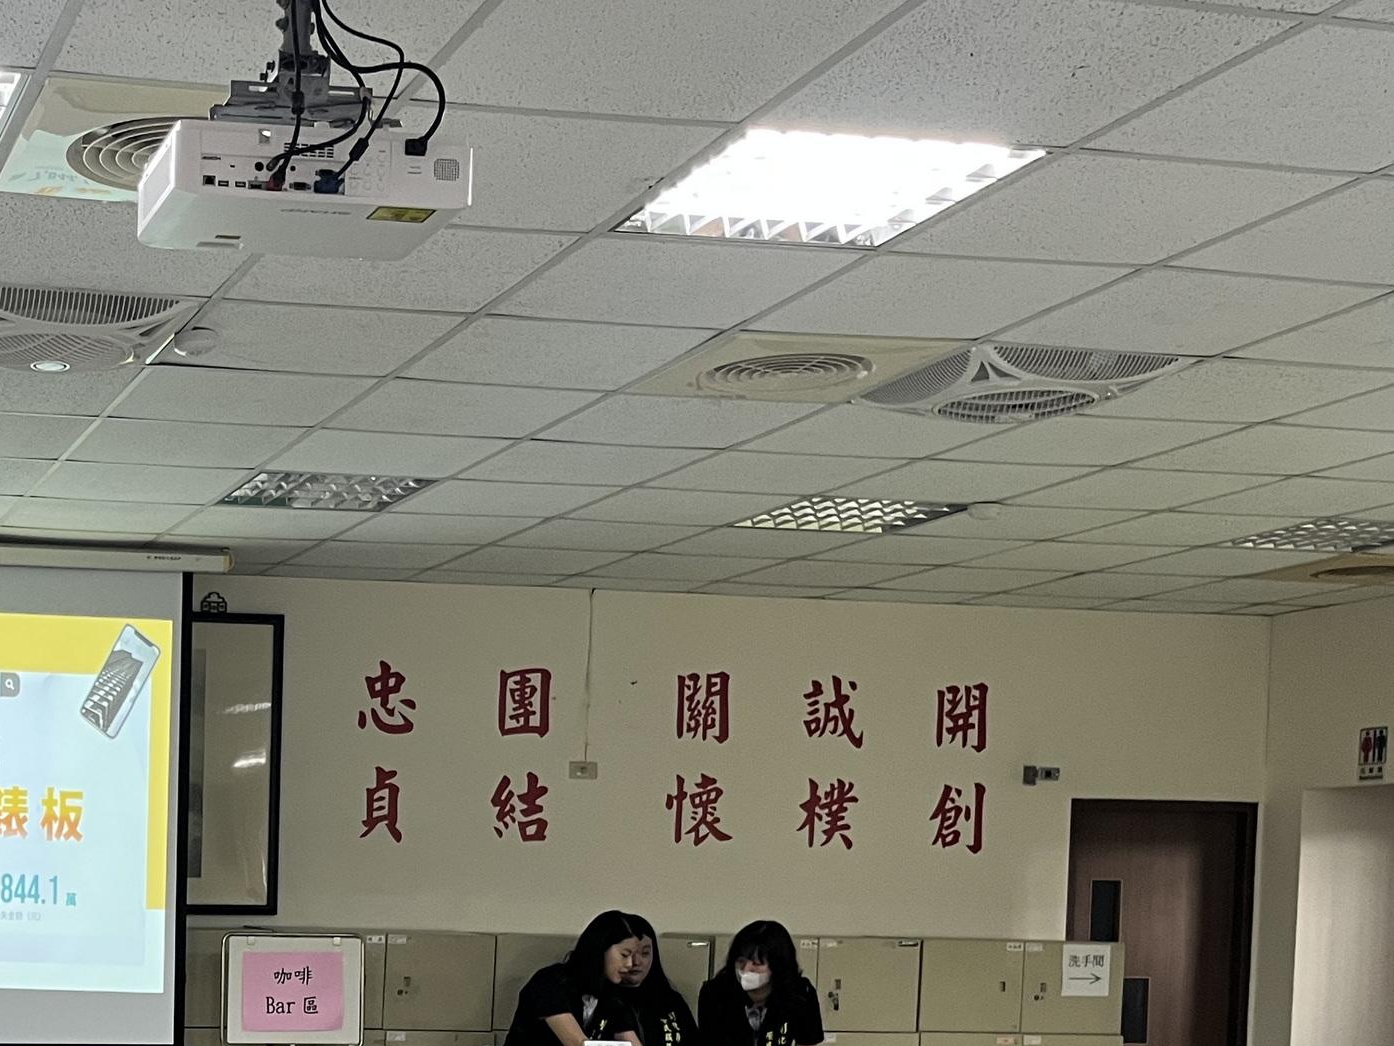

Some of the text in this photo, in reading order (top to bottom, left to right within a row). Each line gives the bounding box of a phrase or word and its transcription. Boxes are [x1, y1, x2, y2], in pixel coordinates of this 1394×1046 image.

[358, 661, 416, 842] 忠貞
[491, 666, 552, 842] 團結
[665, 671, 734, 846] 關懷
[798, 677, 864, 849] 誠樸
[931, 683, 988, 853] 開創
[266, 996, 319, 1015] Bar 區
[273, 966, 313, 985] 咖啡
[1068, 954, 1105, 968] 洗手間
